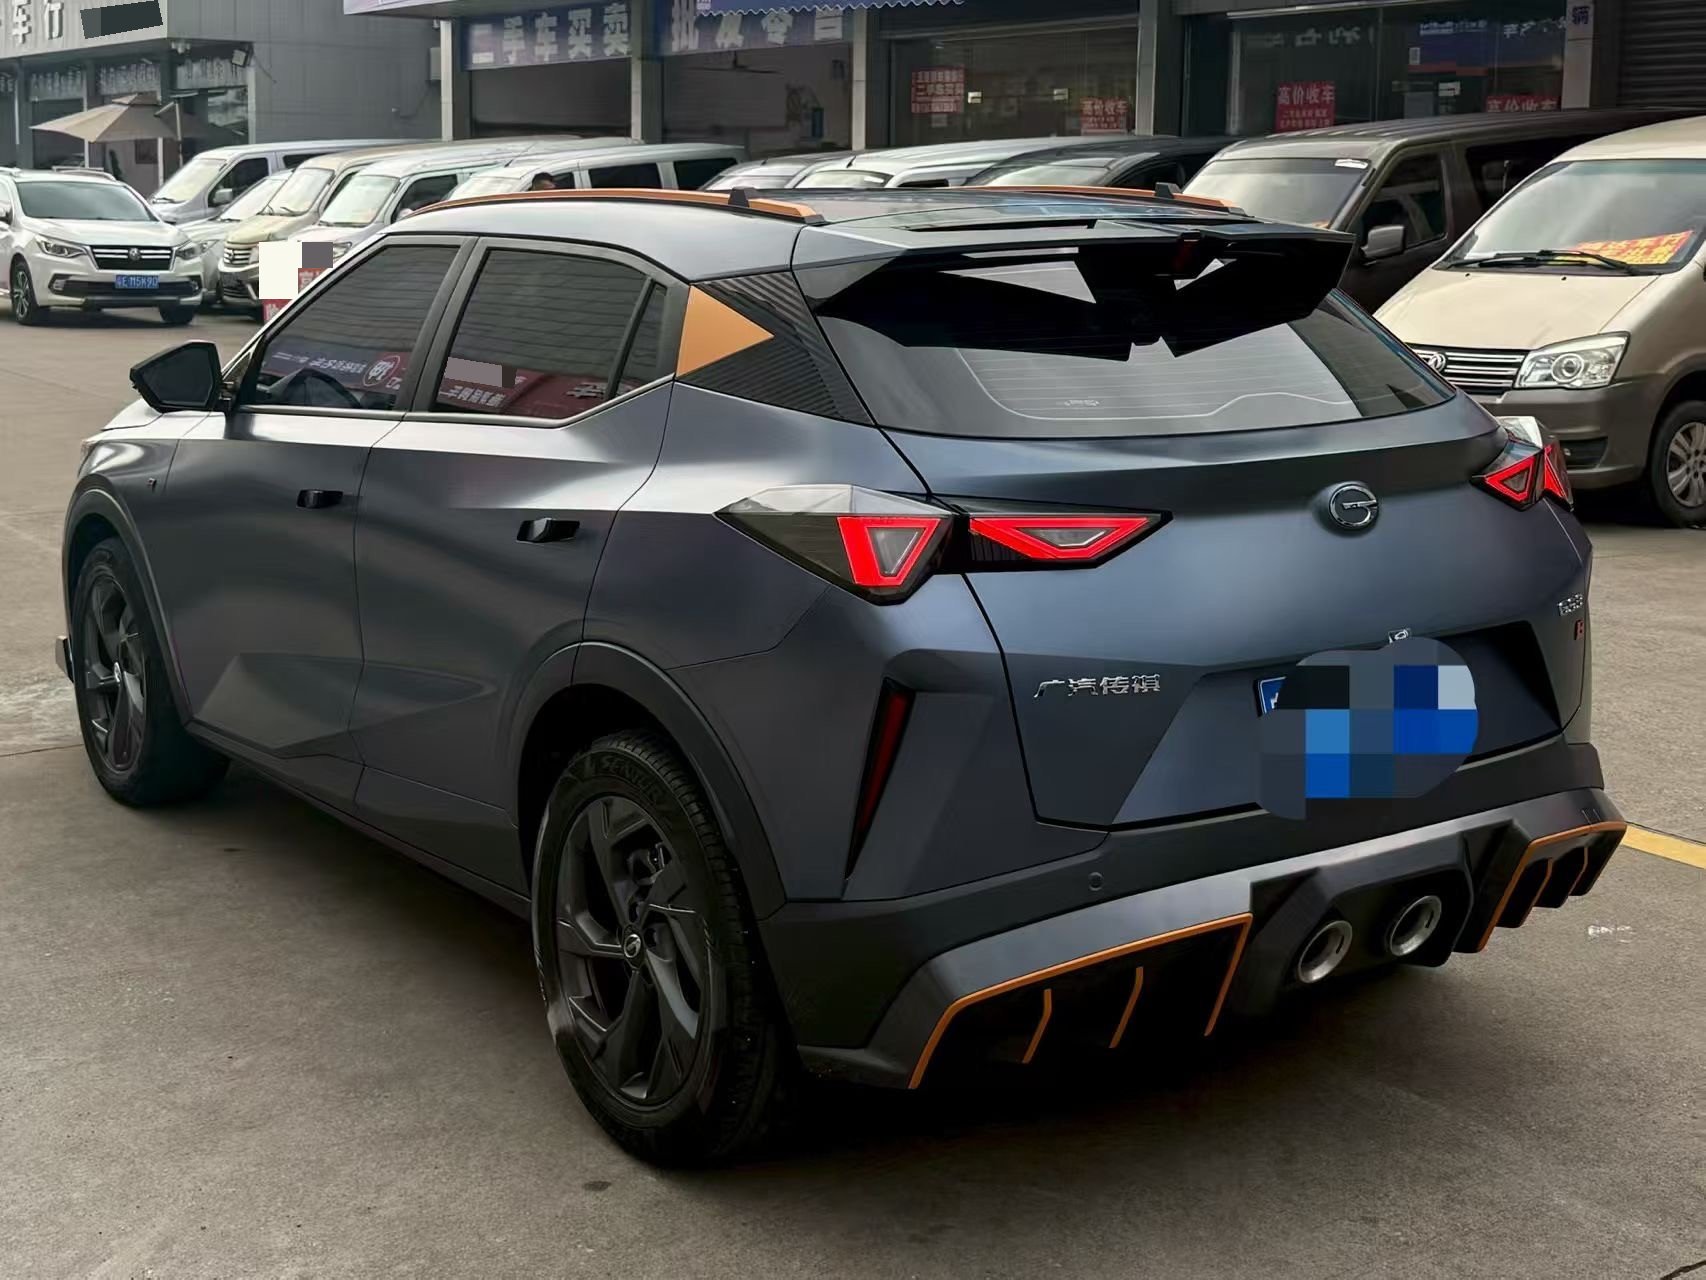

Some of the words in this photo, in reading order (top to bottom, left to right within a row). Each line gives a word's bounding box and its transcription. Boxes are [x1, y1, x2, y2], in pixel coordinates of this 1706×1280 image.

[471, 3, 631, 65] 二手车买卖
[1278, 83, 1335, 105] 高价收车
[1033, 673, 1161, 698] 广汽传祺
